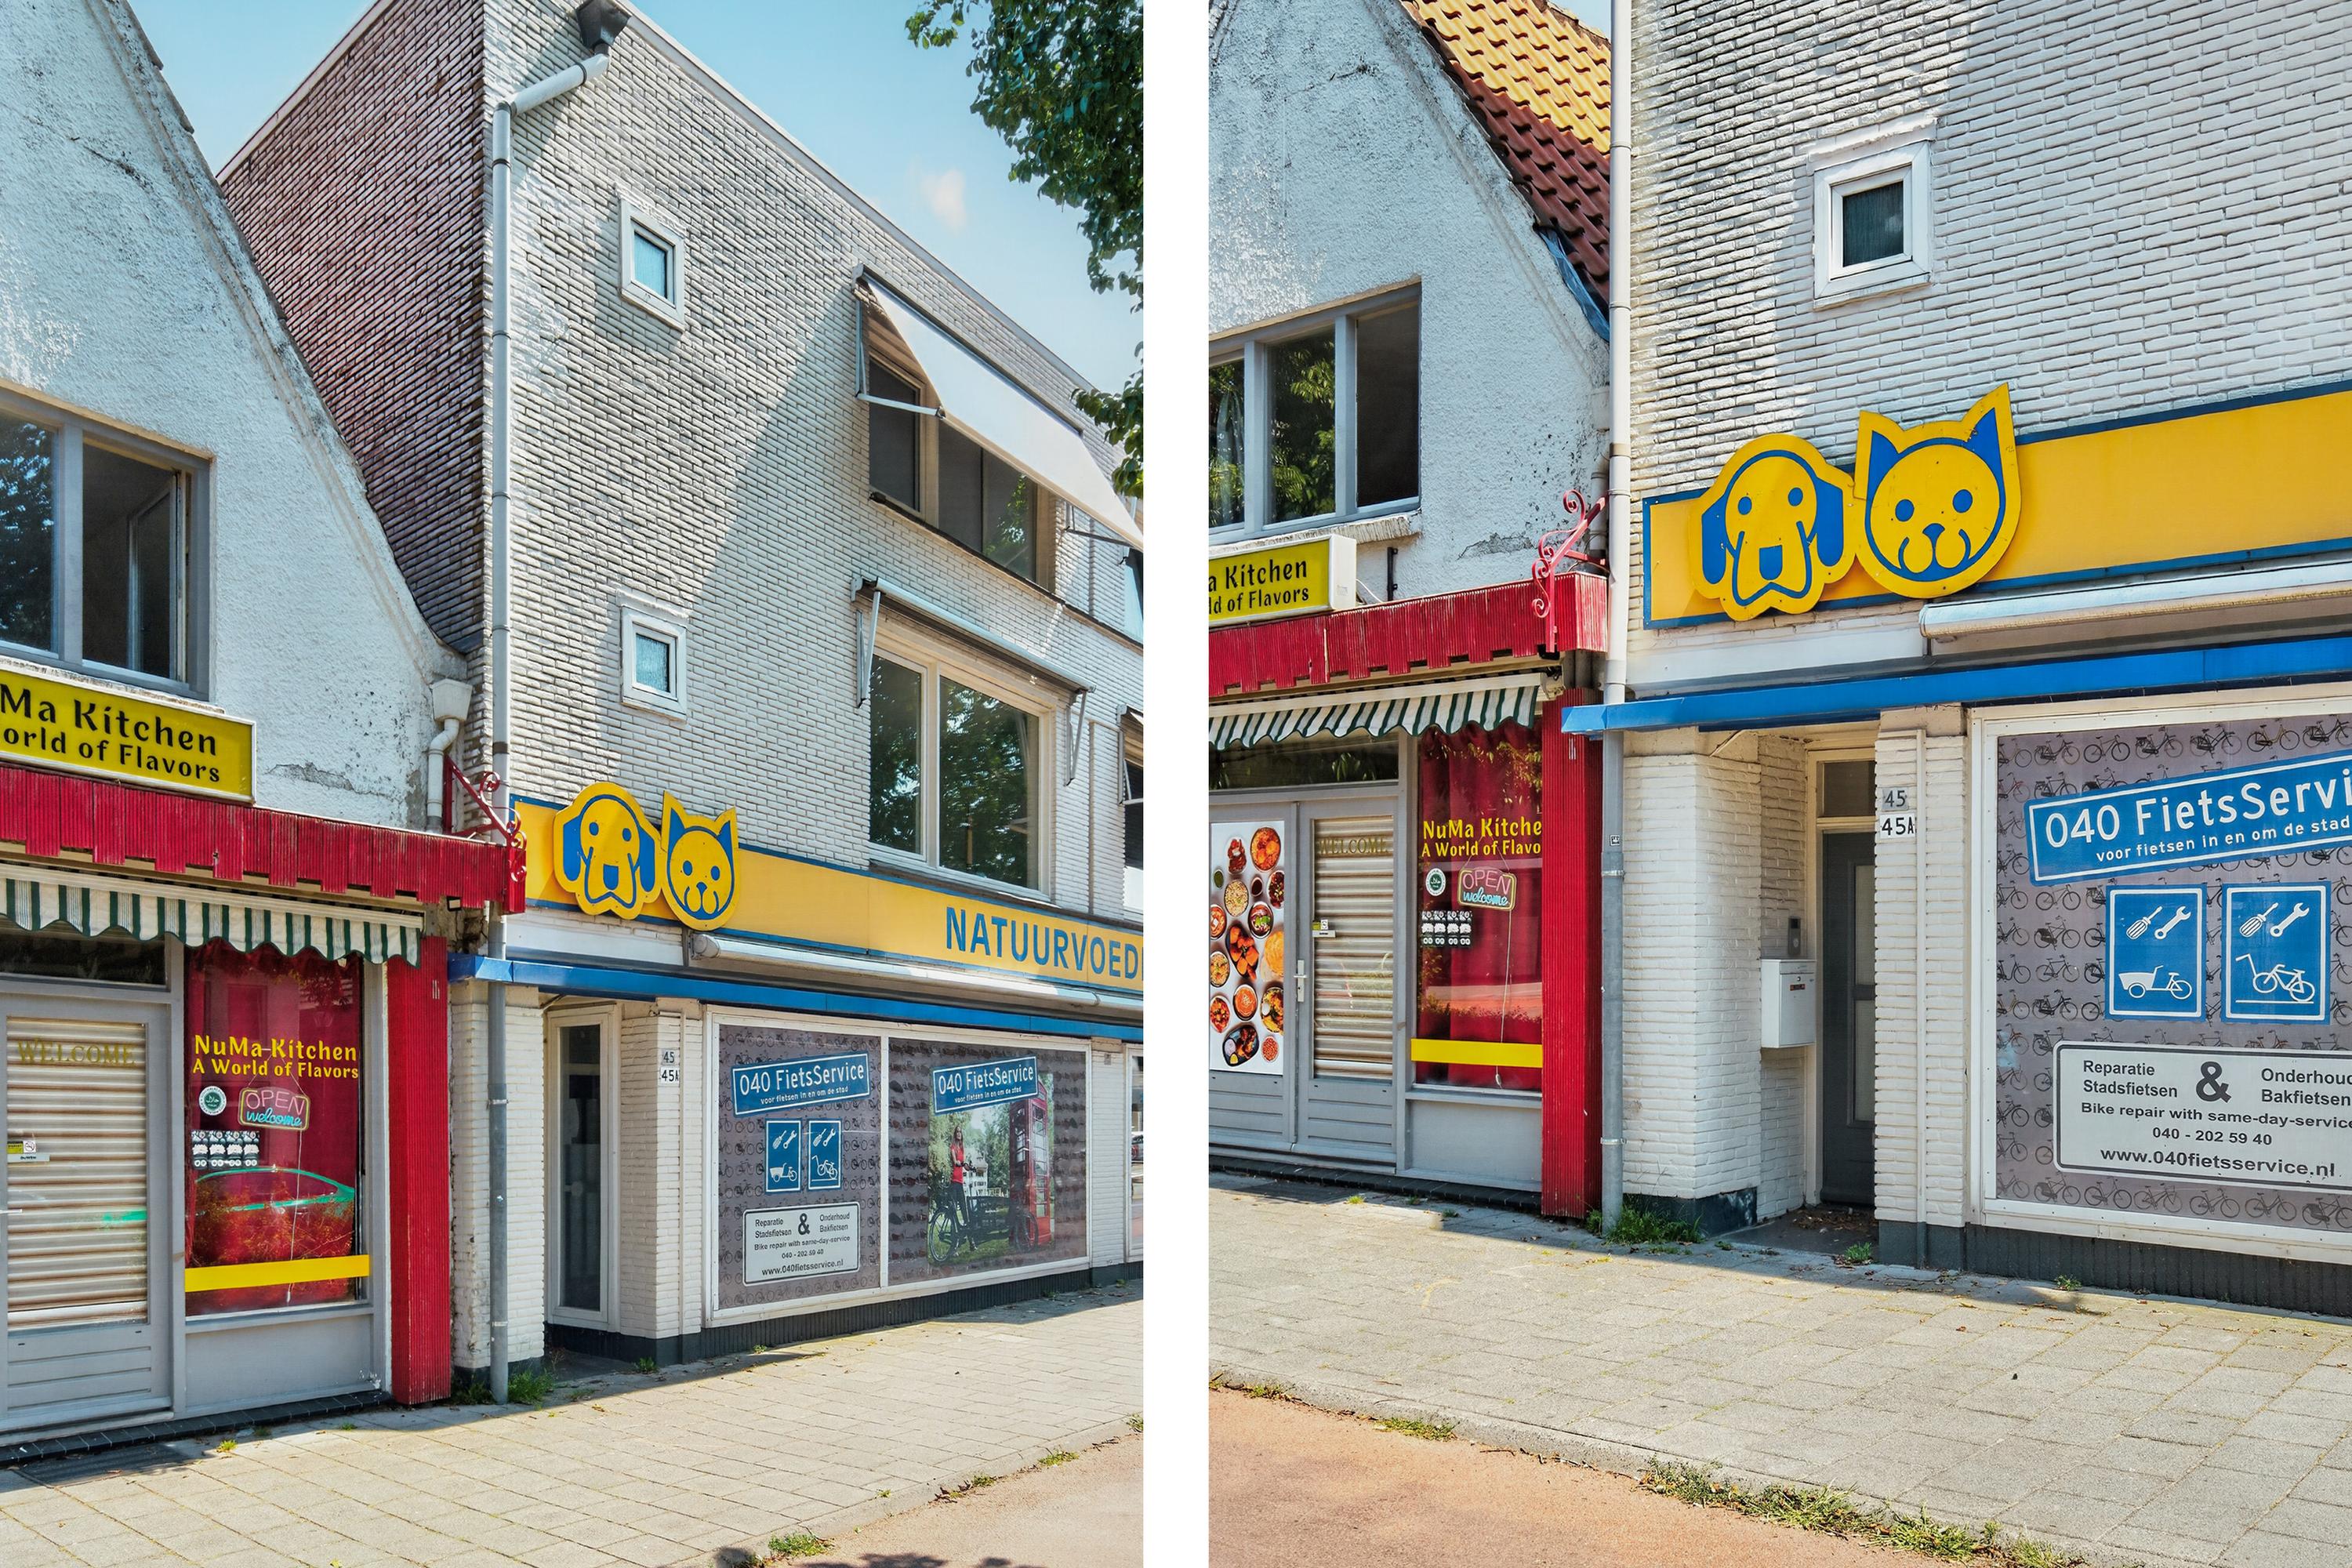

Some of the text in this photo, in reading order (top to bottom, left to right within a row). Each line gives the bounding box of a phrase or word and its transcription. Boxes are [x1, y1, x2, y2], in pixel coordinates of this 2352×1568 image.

[1225, 558, 1307, 589] Kitchen
[1228, 593, 1243, 612] of
[1249, 587, 1308, 608] Flavors
[0, 684, 216, 756] Ma Kitchen
[4, 727, 220, 782] orld of Flavors
[1885, 790, 1905, 808] 45
[2045, 768, 2352, 848] 040 FietsServi
[1423, 816, 1541, 840] NuMa Kitche
[1882, 816, 1914, 836] 45A
[1319, 837, 1387, 855] WELCOME
[1421, 839, 1541, 857] A World of Flavo
[2096, 815, 2350, 862] voor fietsen in en om de stad
[1462, 869, 1511, 895] OPEN
[1463, 887, 1508, 906] welcome
[946, 906, 1143, 981] NATUURVOED
[17, 1037, 136, 1068] WELCOME
[194, 1035, 357, 1061] NuMa Kitchen
[663, 1051, 674, 1063] 45
[193, 1058, 359, 1079] A World of Flavors
[662, 1069, 679, 1082] 45A
[739, 1062, 864, 1095] 040 FietsService
[938, 1064, 1033, 1094] 040 FietsService
[2083, 1060, 2155, 1076] Reparatie
[2195, 1061, 2232, 1103] &
[2083, 1080, 2350, 1106] Stadsfietsen Bakfietsen
[245, 1090, 305, 1116] OPEN
[776, 1093, 799, 1102] fietsen
[966, 1092, 984, 1102] fietsen
[246, 1108, 303, 1127] welcome
[2082, 1102, 2114, 1115] Bike
[2120, 1105, 2165, 1119] repair
[2169, 1109, 2202, 1120] with
[2152, 1127, 2180, 1139] 040
[2195, 1129, 2223, 1142] 202
[2229, 1131, 2248, 1144] 59
[2253, 1133, 2272, 1145] 40
[2100, 1149, 2336, 1177] www.040fietsservice.nl
[755, 1212, 850, 1236] Reparatie & Onderhoud
[755, 1224, 848, 1238] Stadsfietsen Bakfietsen
[769, 1241, 786, 1250] repair
[802, 1236, 850, 1246] same-day-service
[762, 1259, 844, 1276] www.040fietsservice.nl
